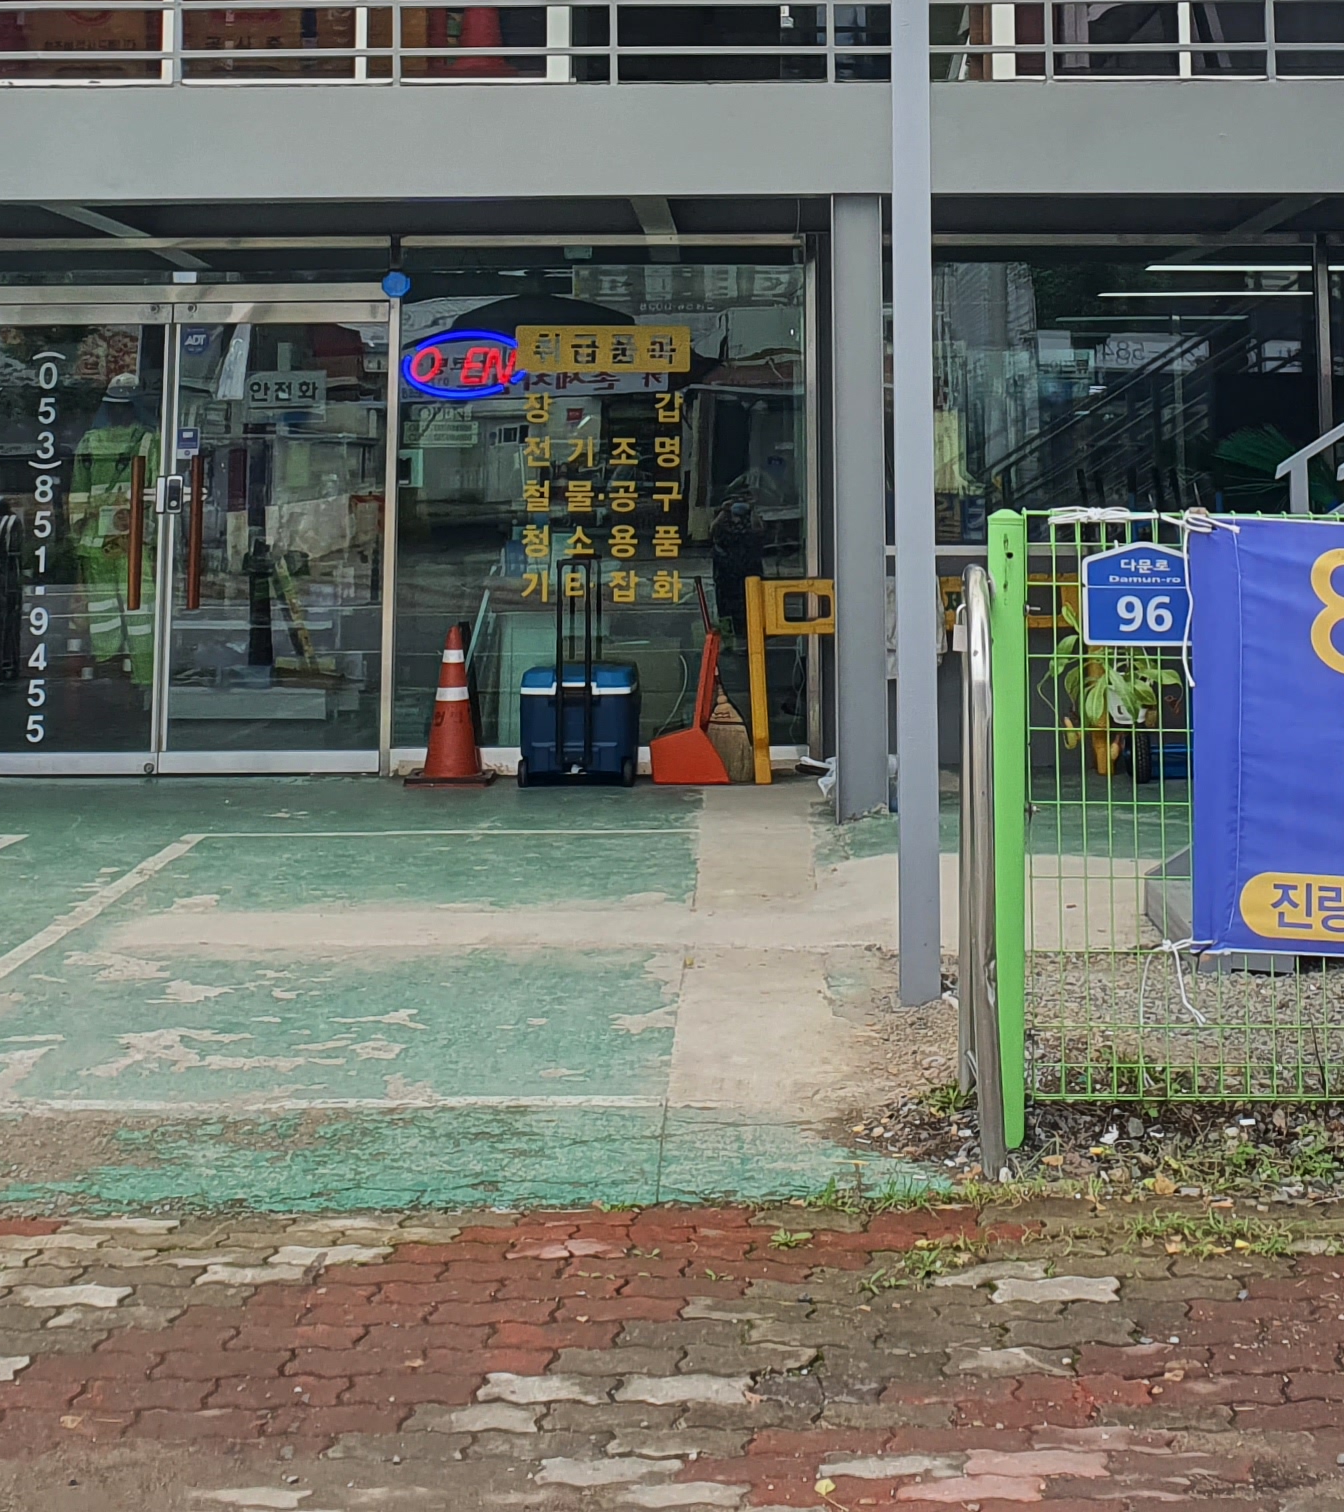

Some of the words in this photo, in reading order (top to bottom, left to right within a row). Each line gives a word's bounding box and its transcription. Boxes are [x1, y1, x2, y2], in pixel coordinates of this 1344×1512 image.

[249, 381, 318, 403] 안전화
[522, 435, 682, 468] 전기조명
[521, 525, 682, 558] 청소용품
[1108, 575, 1181, 584] Damun-ro
[1120, 558, 1171, 574] 다문로
[1116, 595, 1173, 632] 96
